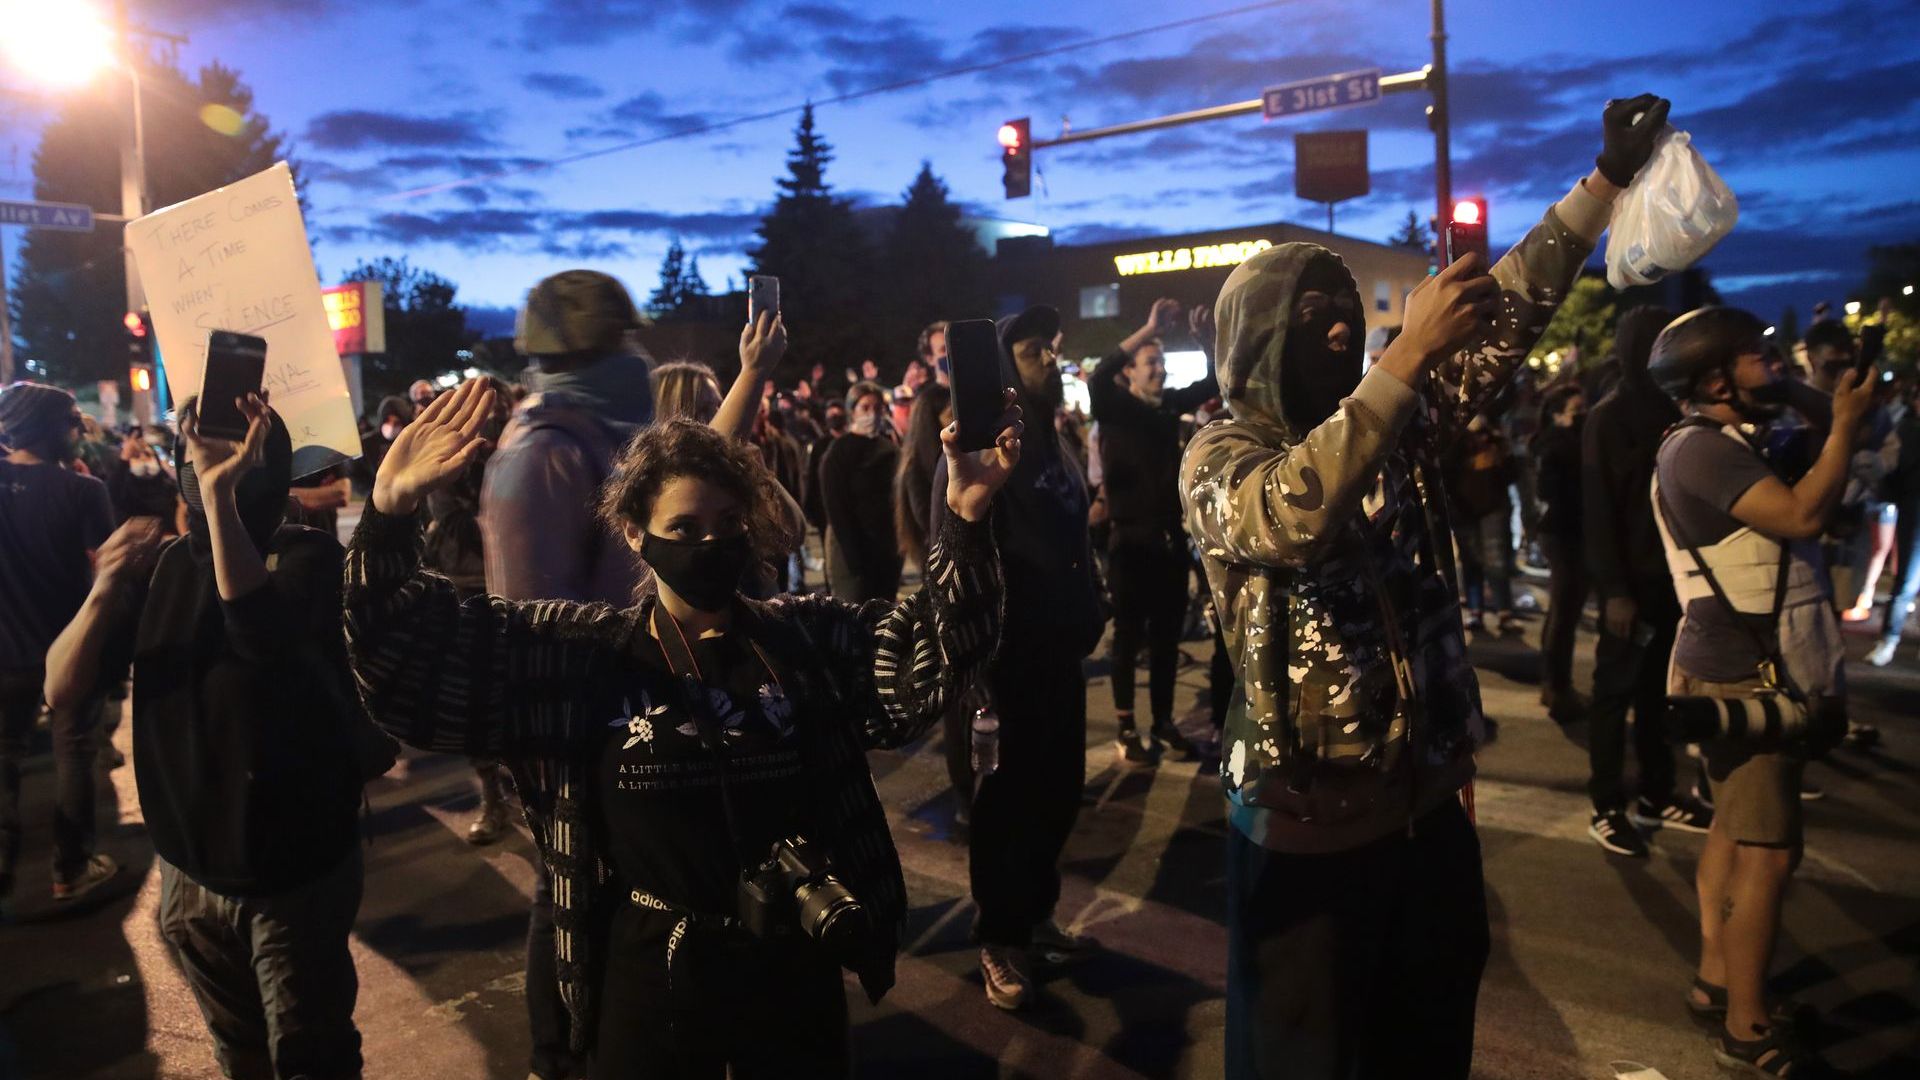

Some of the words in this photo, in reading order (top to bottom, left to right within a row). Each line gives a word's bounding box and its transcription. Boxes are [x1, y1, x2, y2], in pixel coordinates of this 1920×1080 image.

[1268, 93, 1284, 114] E
[1292, 86, 1338, 110] 31st
[1348, 78, 1372, 101] St
[53, 207, 81, 226] Av
[146, 210, 216, 248] THERE
[178, 257, 196, 283] A
[198, 239, 248, 269] TIME
[1113, 248, 1191, 276] WELLS
[172, 288, 215, 315] WHEN
[194, 294, 294, 330] SILENCE
[618, 764, 628, 774] A
[631, 763, 681, 774] LITTLE
[617, 780, 626, 789] A
[629, 781, 677, 790] LITTLE
